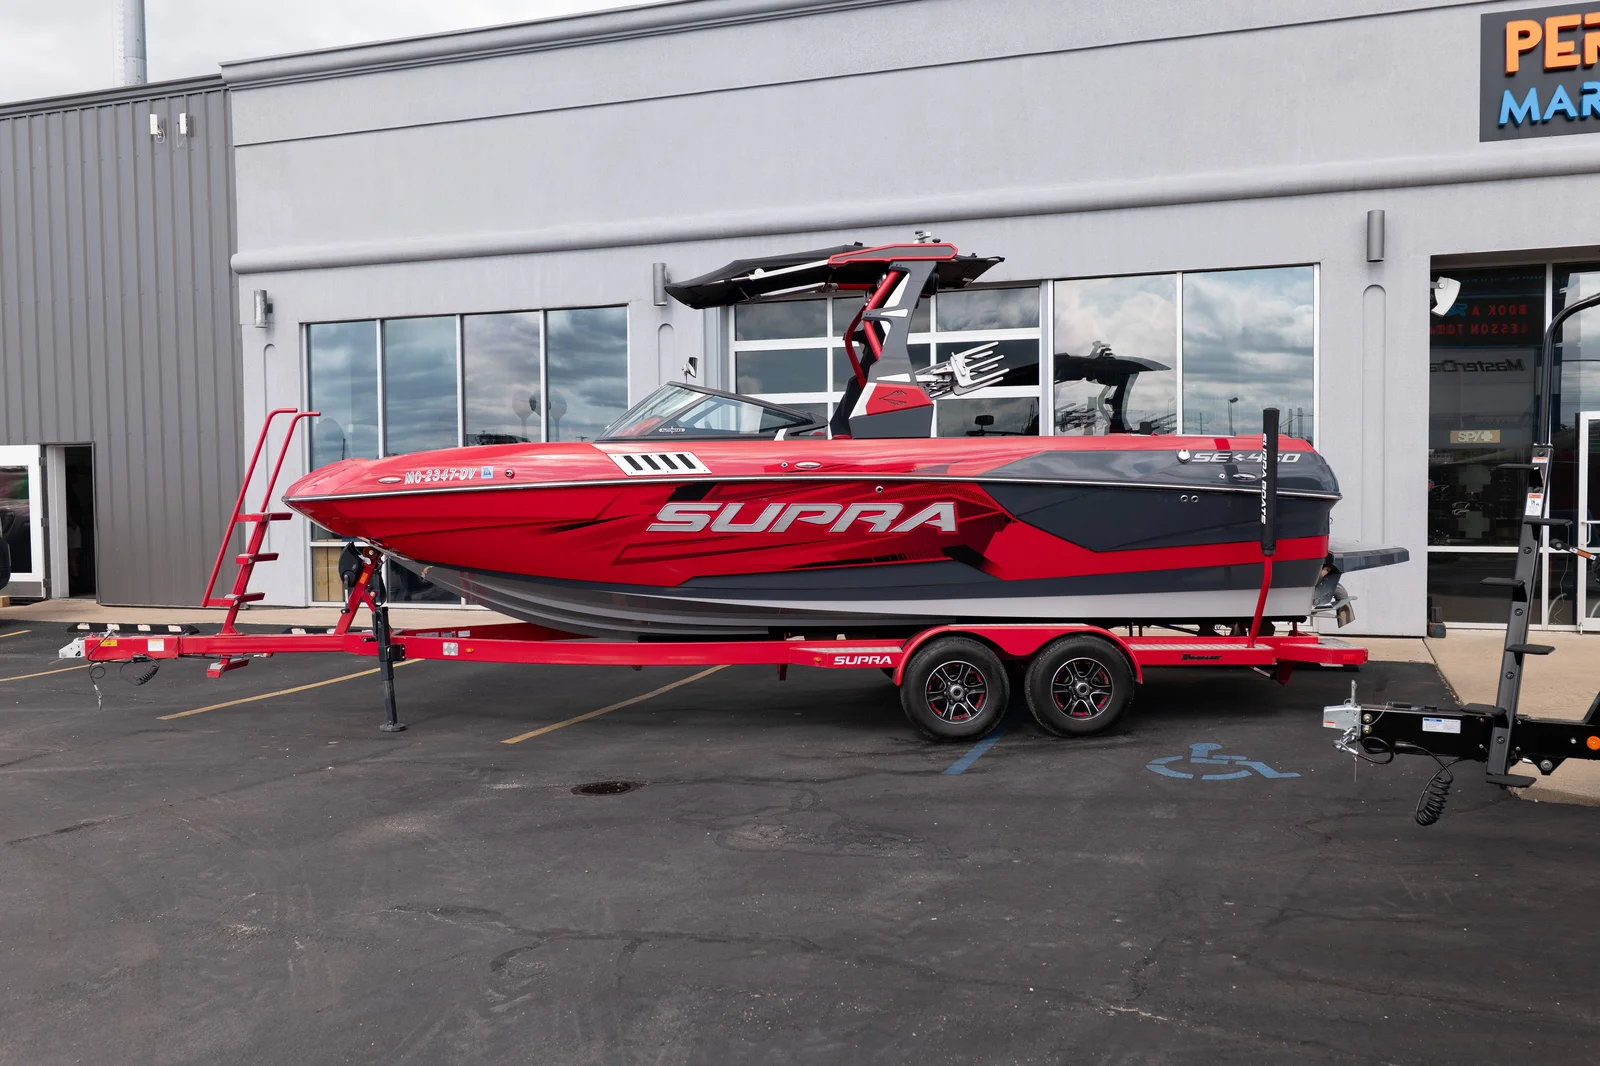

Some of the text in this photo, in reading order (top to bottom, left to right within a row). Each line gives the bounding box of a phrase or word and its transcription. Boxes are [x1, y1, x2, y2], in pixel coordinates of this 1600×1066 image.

[1457, 430, 1482, 442] SPY
[1246, 452, 1302, 463] 40
[646, 502, 958, 533] SUPRA
[833, 655, 893, 665] SUPRA
